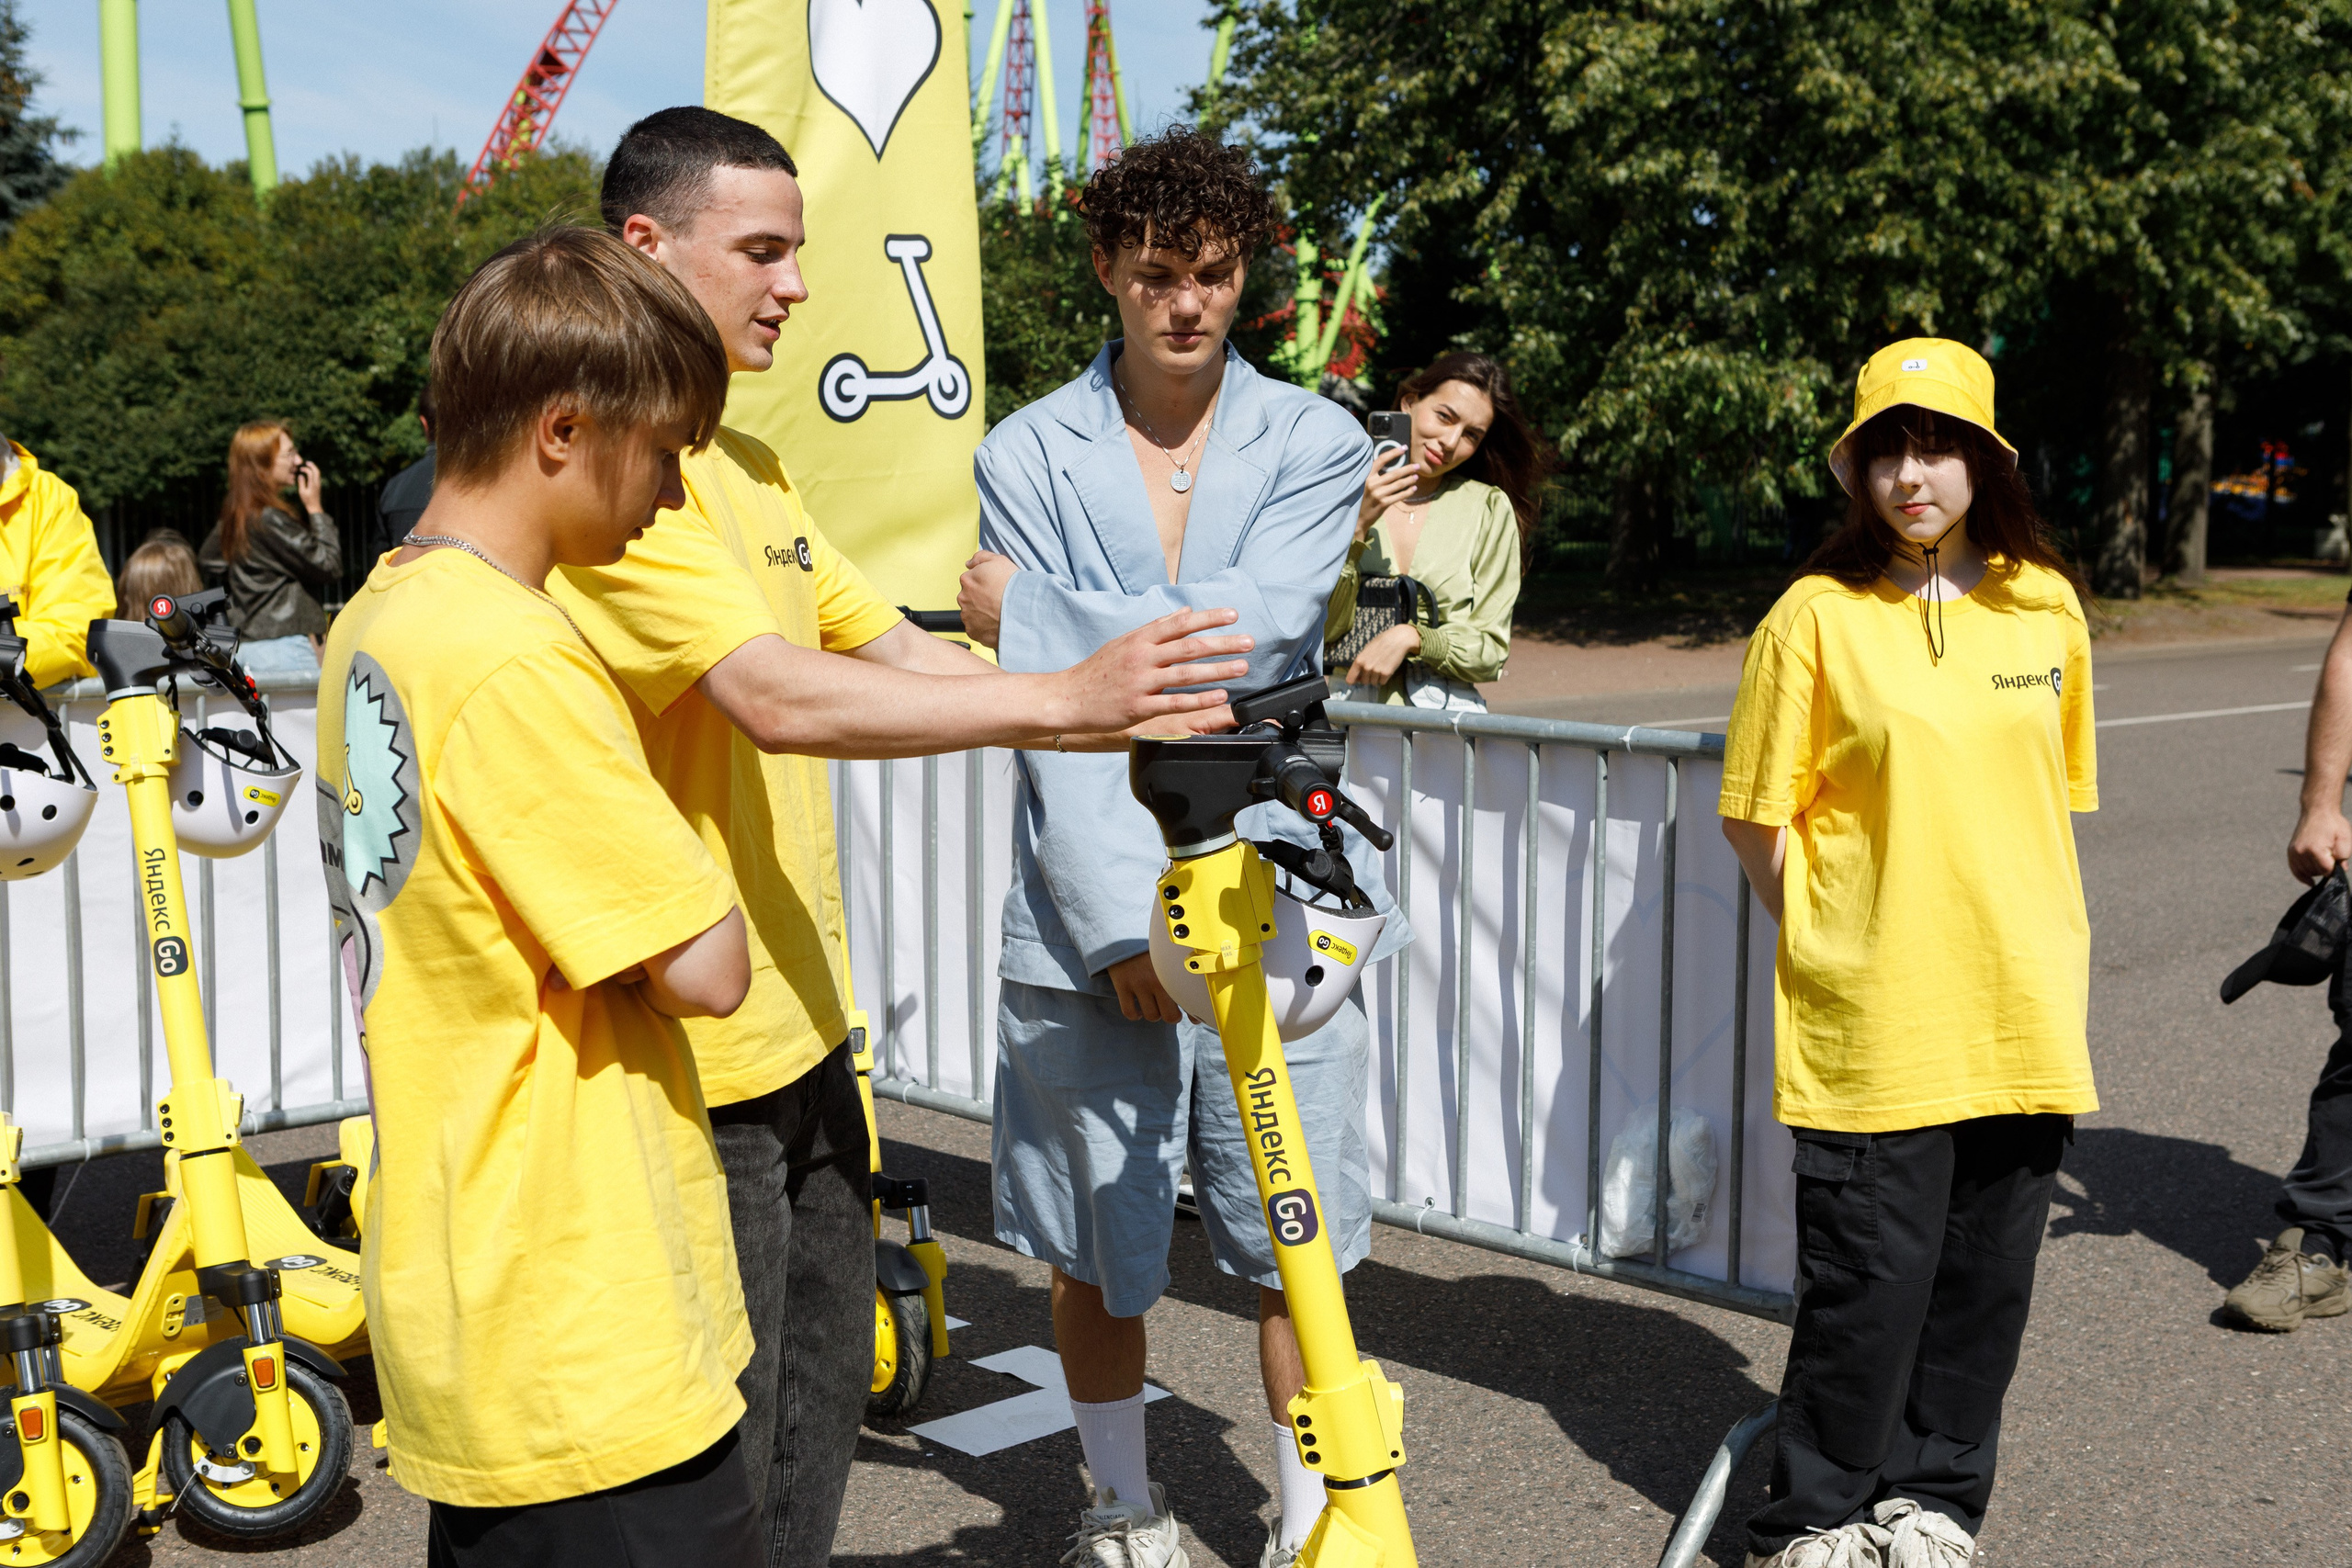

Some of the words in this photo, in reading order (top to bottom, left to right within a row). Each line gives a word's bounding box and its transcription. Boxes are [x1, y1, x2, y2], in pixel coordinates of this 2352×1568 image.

[764, 545, 797, 568] Яндек
[157, 601, 166, 613] Я
[1991, 674, 2051, 690] Яндекс
[1313, 794, 1327, 812] Я
[144, 848, 170, 931] Яндекс
[157, 940, 181, 974] Go
[1318, 937, 1329, 948] Go
[1331, 942, 1352, 959] Яндекс
[1245, 1067, 1292, 1185] Яндекс
[1275, 1196, 1306, 1241] Go
[280, 1256, 318, 1269] Go
[42, 1299, 82, 1314] Go
